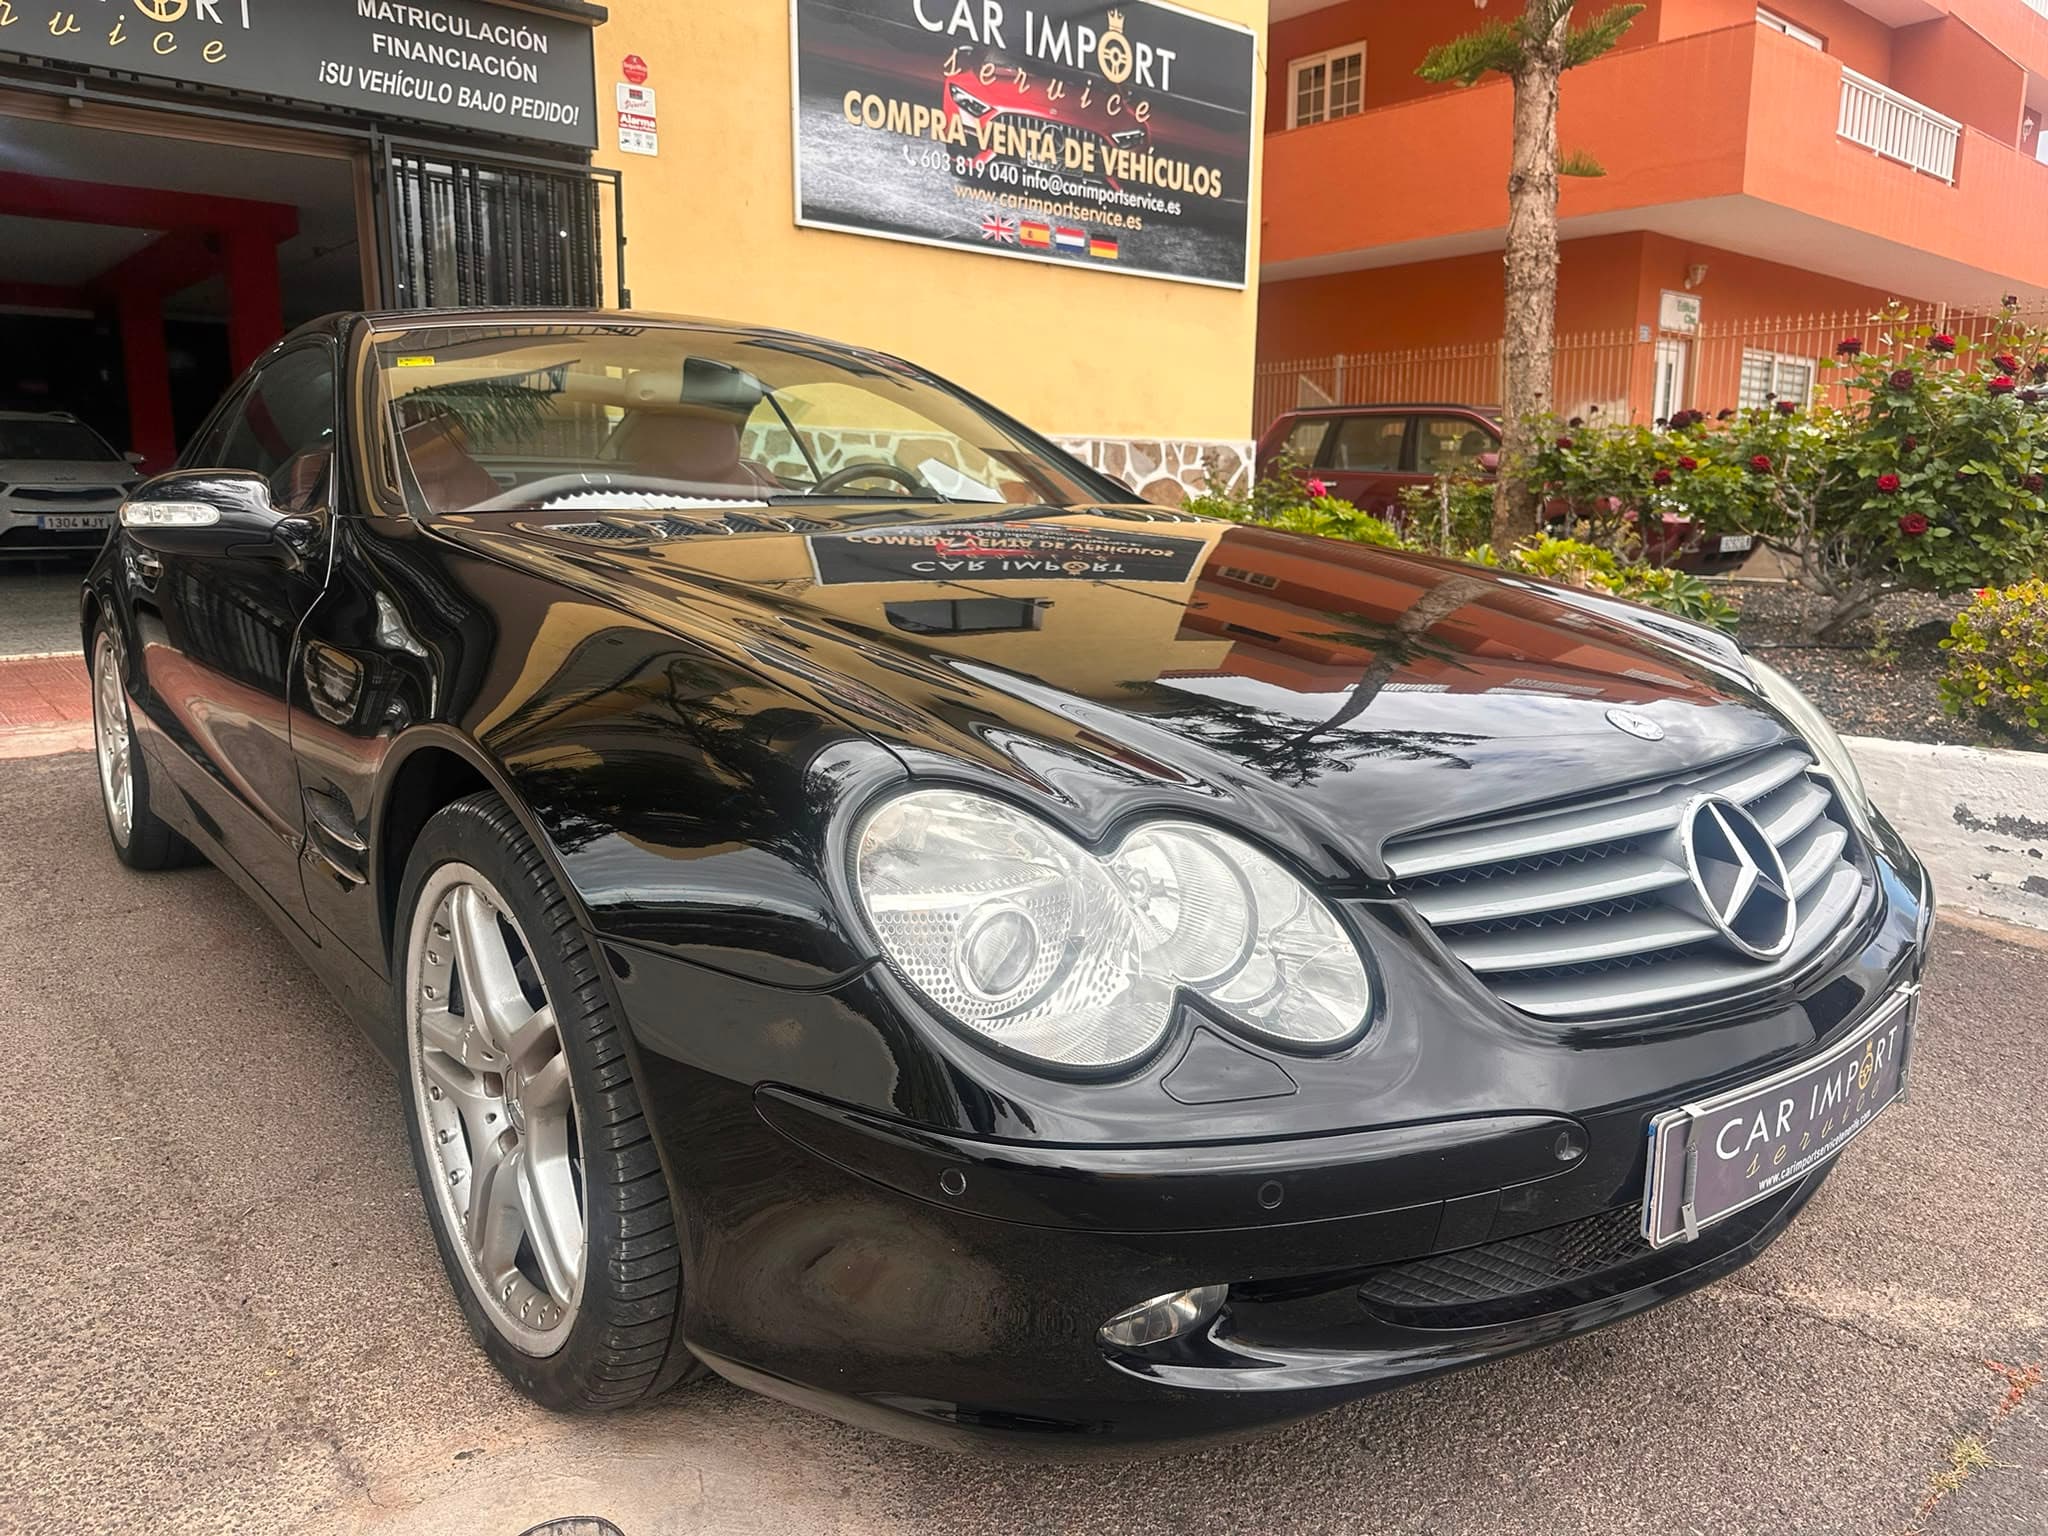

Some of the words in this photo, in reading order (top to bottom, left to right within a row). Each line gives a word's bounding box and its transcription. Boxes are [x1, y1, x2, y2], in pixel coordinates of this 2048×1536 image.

[357, 0, 548, 54] MATRICULACIÓN
[372, 33, 538, 84] FINANCIACIÓN
[913, 0, 1006, 49] CAR
[1025, 8, 1177, 92] IMPORT
[319, 60, 353, 87] ¡SU
[358, 68, 453, 105] VEHÍCULO
[457, 86, 506, 114] BAJO
[510, 95, 579, 126] PEDIDO!
[943, 47, 1151, 123] service
[843, 89, 967, 147] COMPRA
[974, 117, 1057, 166] VENTA
[1064, 137, 1095, 172] DE
[1101, 146, 1222, 198] VEHÍCULOS
[920, 150, 951, 172] 603
[956, 156, 985, 178] 819
[989, 165, 1018, 185] 040
[1022, 168, 1181, 216] info@carimportservice.es
[953, 184, 1143, 231] www.carimportservice.es
[1715, 1099, 1794, 1160] CAR
[1809, 1025, 1898, 1121] IMPORT
